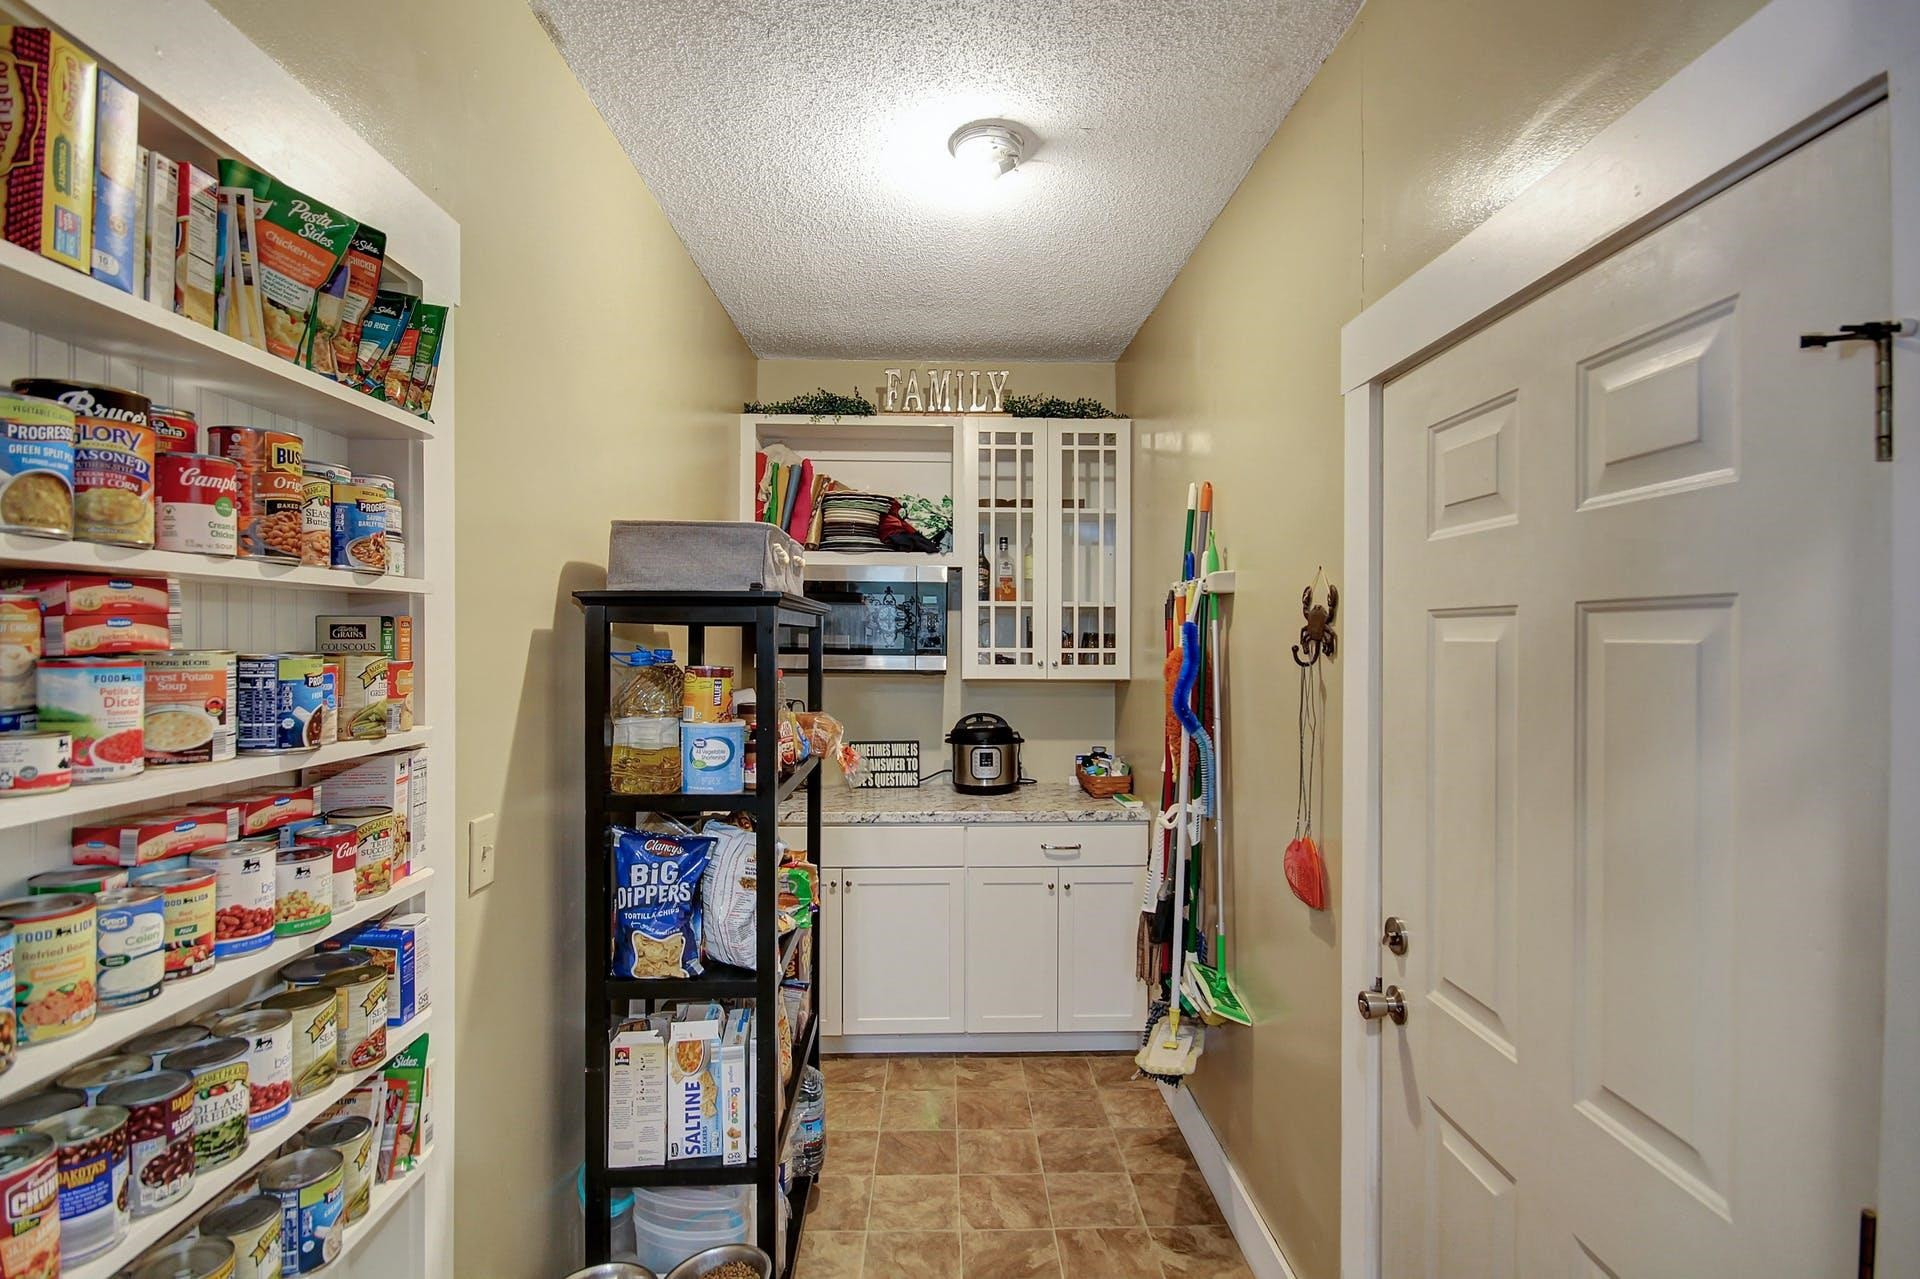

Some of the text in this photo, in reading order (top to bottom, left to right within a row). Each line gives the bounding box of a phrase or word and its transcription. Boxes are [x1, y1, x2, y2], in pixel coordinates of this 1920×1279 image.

[288, 199, 347, 230] Pasta
[298, 223, 334, 251] Sides
[266, 231, 309, 258] Chicken
[373, 321, 391, 332] RICE
[884, 368, 1010, 412] FAMILY
[9, 444, 41, 456] GREEN
[108, 479, 139, 492] CORN
[276, 502, 299, 510] BAKED
[332, 629, 365, 640] GRAINS
[321, 642, 377, 652] COUSCOUS
[94, 674, 120, 684] FOOD
[181, 672, 214, 683] Potato
[158, 681, 188, 693] Soup
[104, 696, 140, 709] Diced
[702, 749, 726, 757] Vegetable
[891, 743, 910, 757] WINE
[910, 743, 919, 757] IS
[700, 754, 727, 762] Shortening
[869, 758, 919, 772] ANSWER TO
[874, 772, 919, 788] QUESTIONS
[624, 908, 681, 921] TORTILLA CHIPS
[16, 929, 53, 945] FOOD
[22, 946, 64, 961] Refried
[392, 1052, 418, 1070] Sides
[685, 1081, 701, 1156] SALTINE
